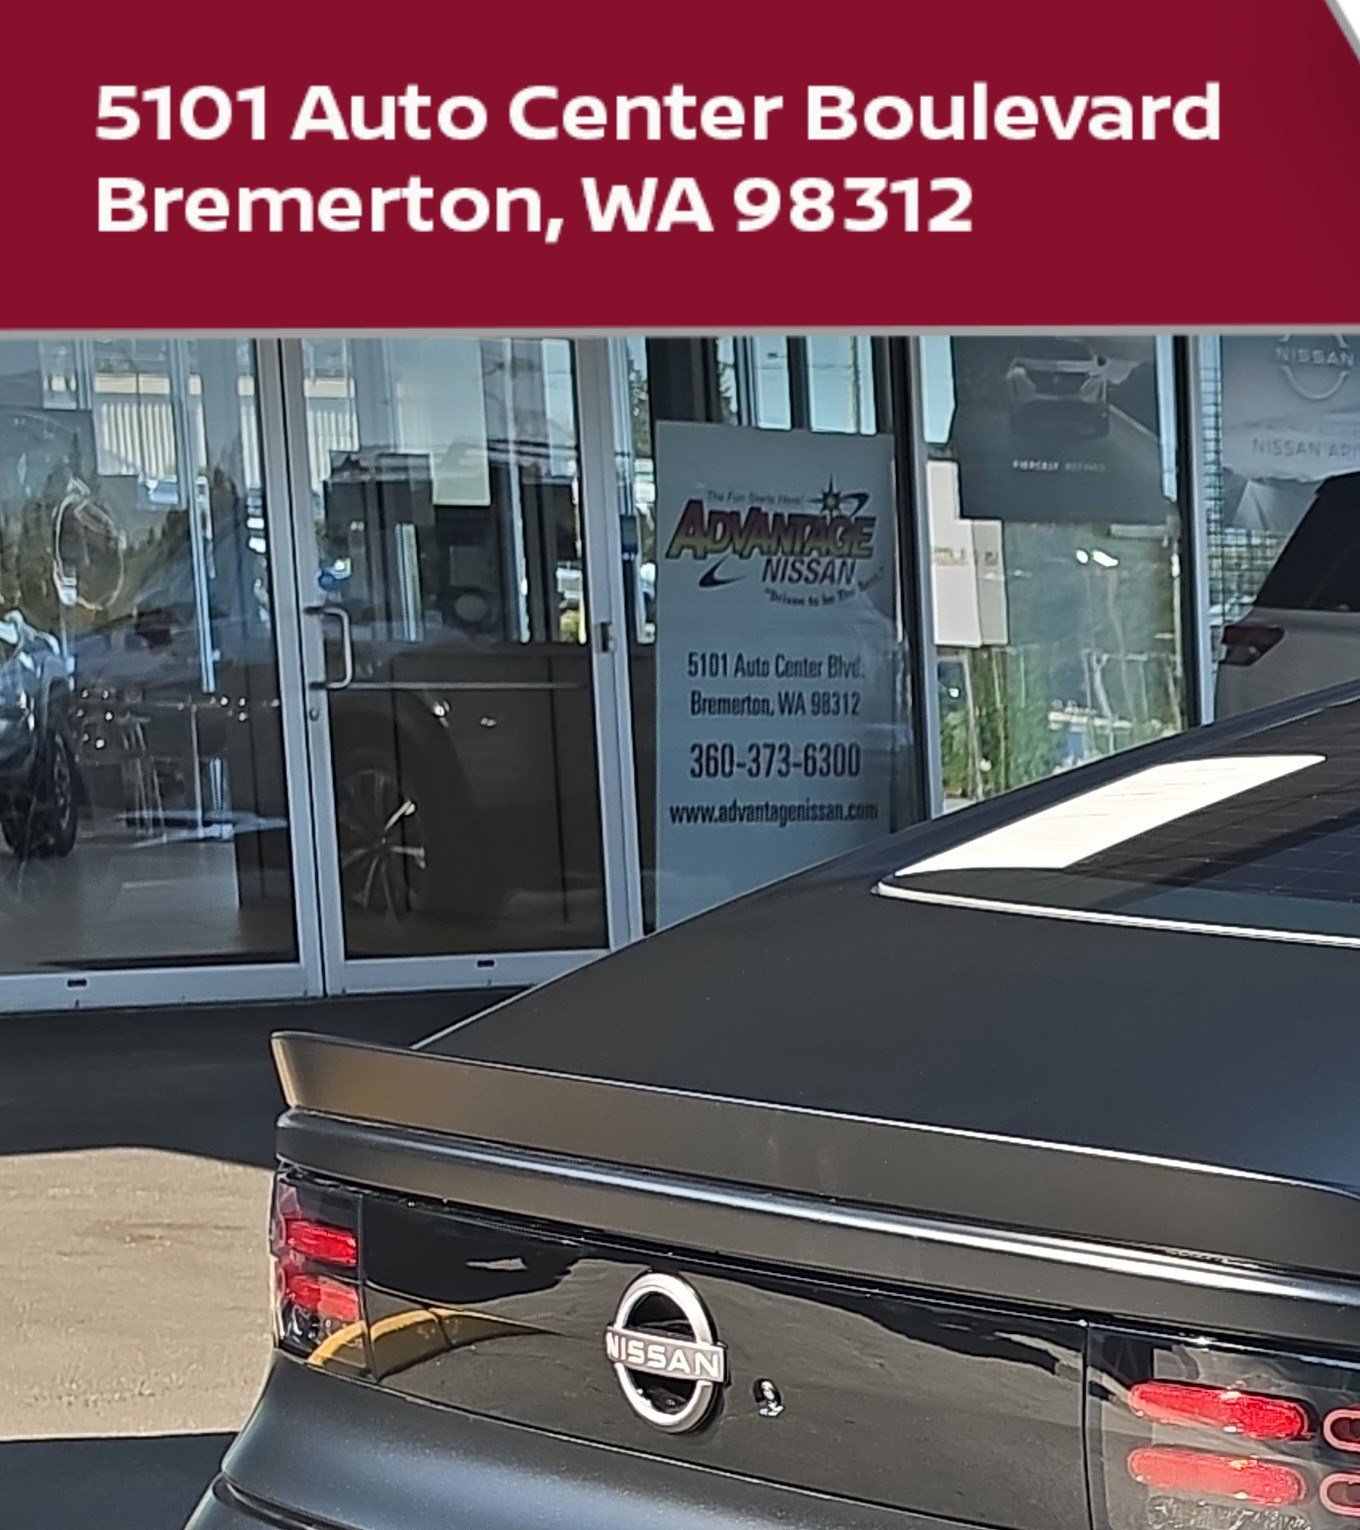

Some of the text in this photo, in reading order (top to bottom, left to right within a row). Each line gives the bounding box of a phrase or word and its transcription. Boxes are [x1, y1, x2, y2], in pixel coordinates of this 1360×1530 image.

[1276, 347, 1354, 366] NISSAN
[1252, 438, 1321, 457] NISSAN
[665, 498, 877, 560] ADVANTAGE
[762, 556, 857, 585] NISSAN
[686, 651, 865, 680] 5101 Auto Center Blvd.
[690, 690, 861, 717] Bremerton, WA 98312
[689, 742, 862, 779] 360-373-6300
[669, 798, 879, 828] www.advantagenissan.com
[605, 1331, 720, 1378] NISSAN
